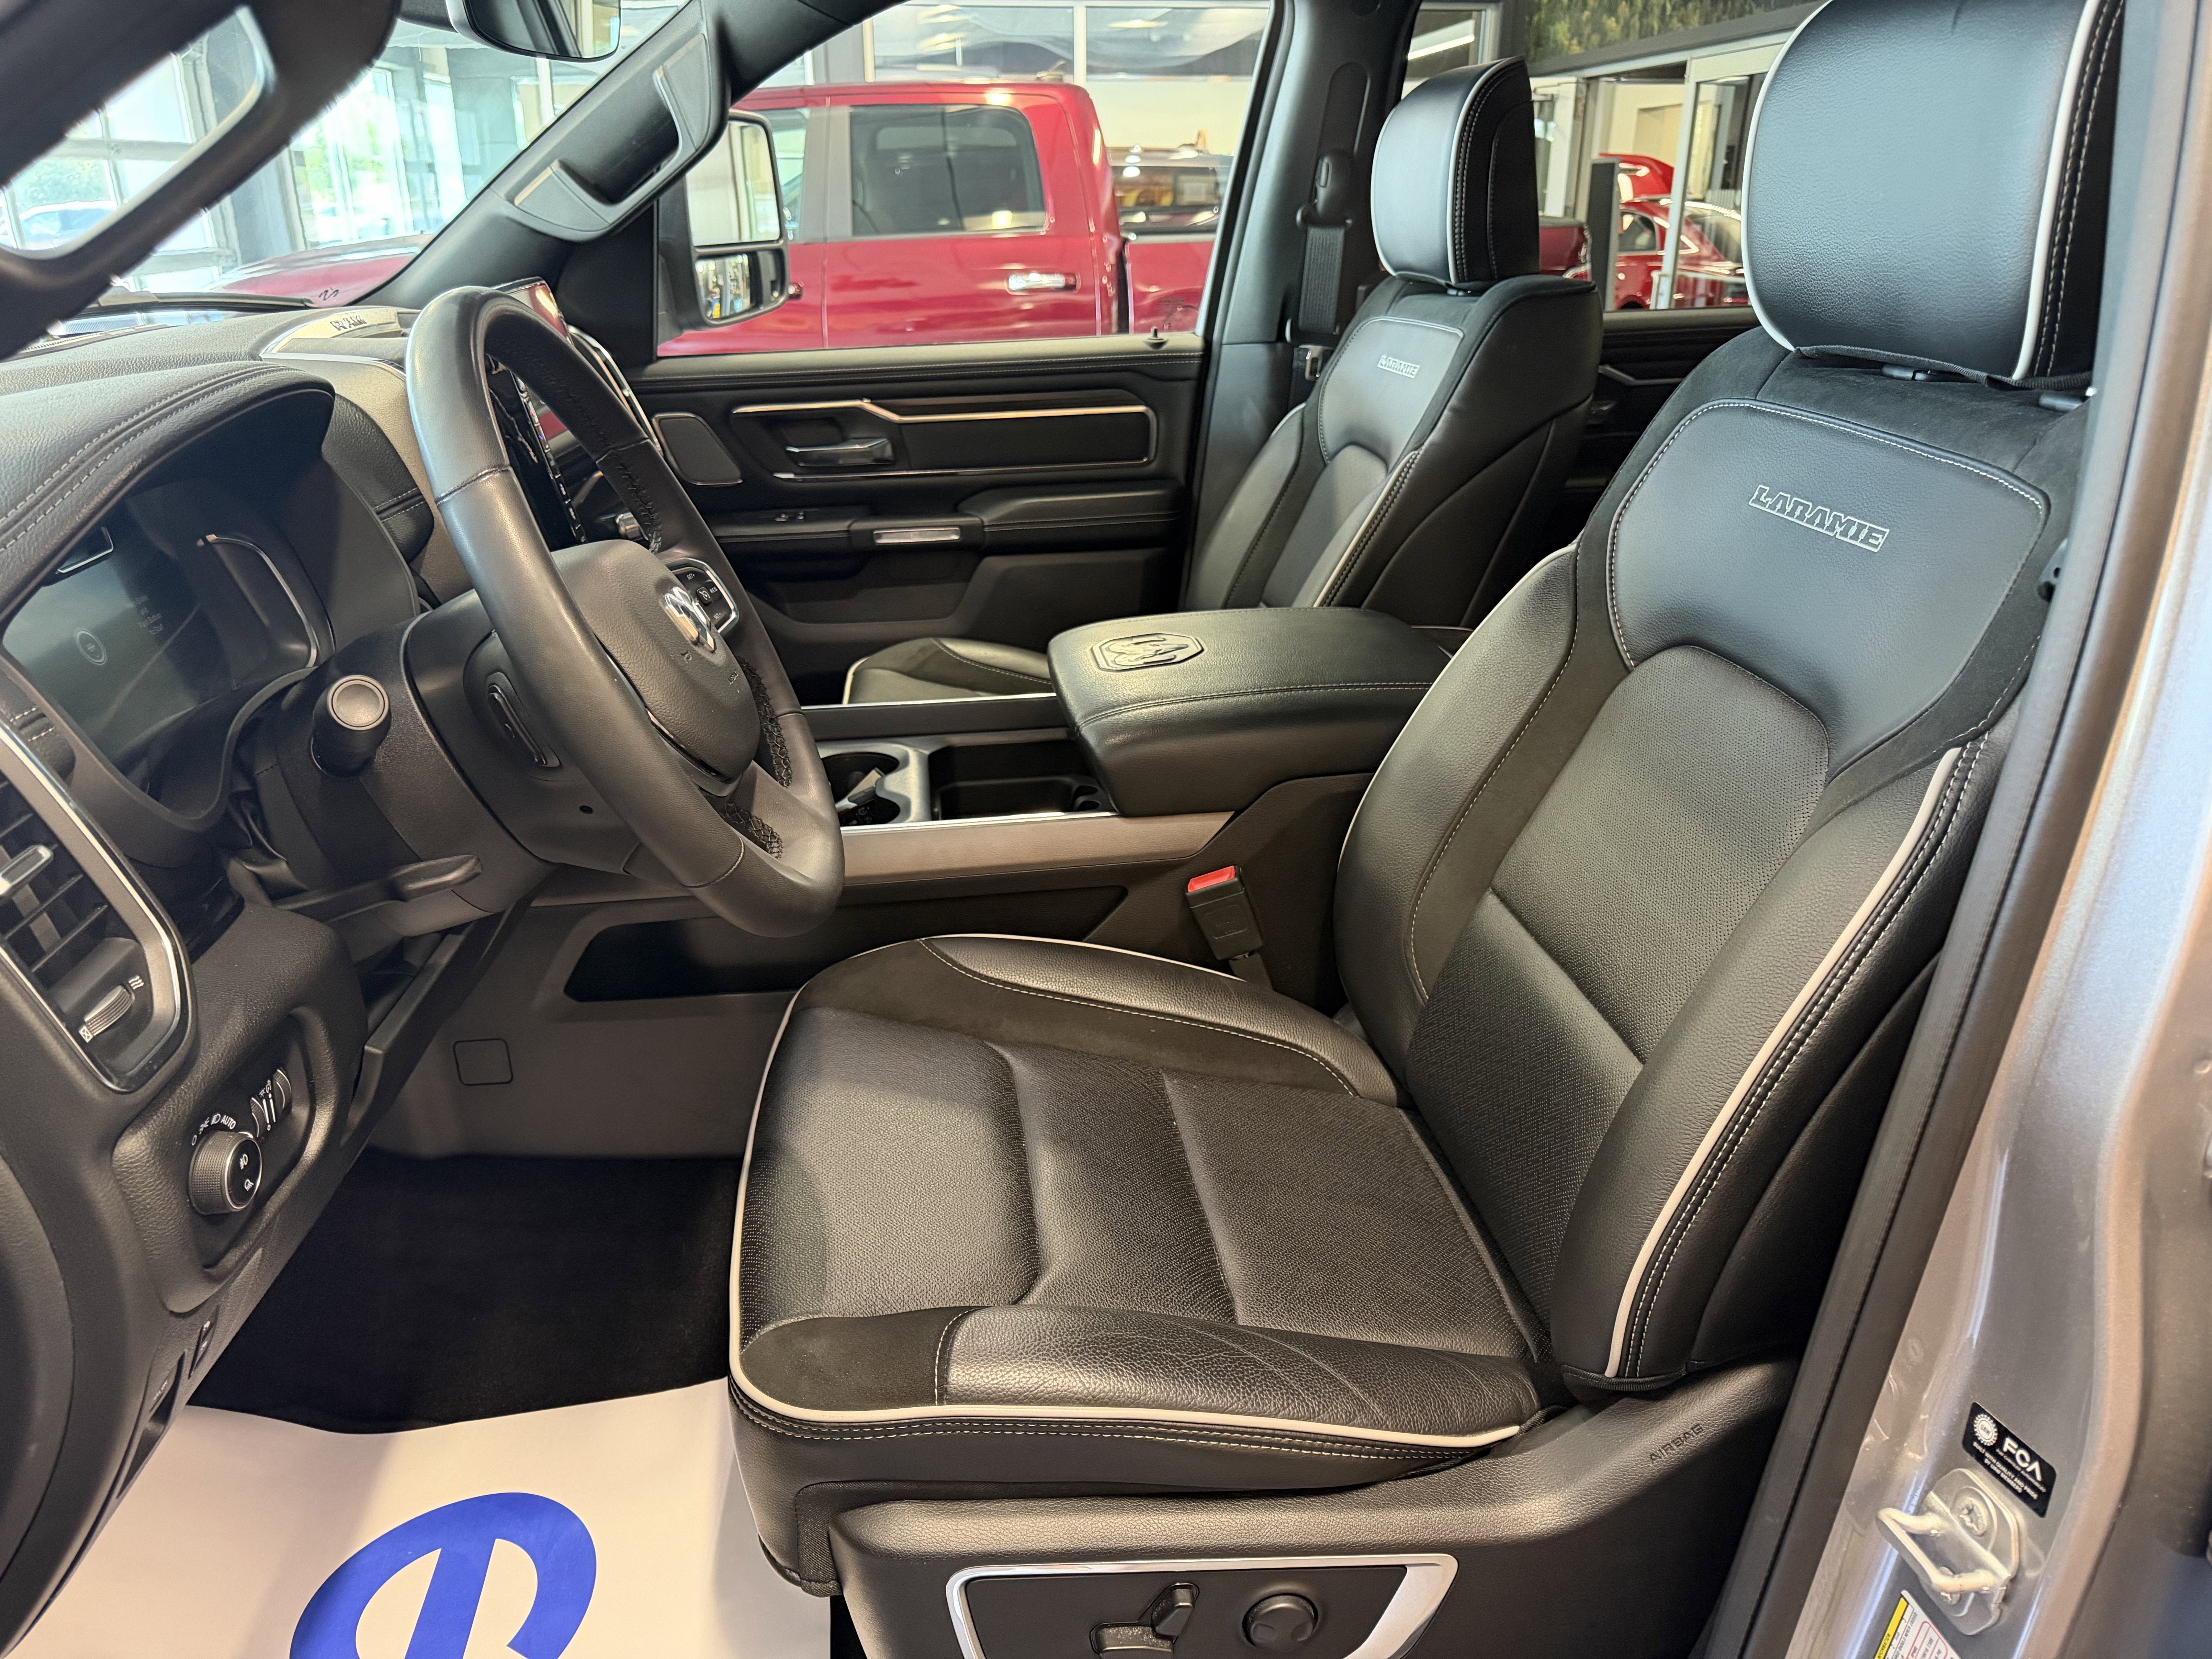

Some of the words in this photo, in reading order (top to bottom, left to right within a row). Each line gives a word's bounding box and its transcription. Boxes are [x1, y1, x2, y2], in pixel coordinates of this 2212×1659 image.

[1748, 484, 1890, 553] LARAMIE
[220, 1115, 236, 1130] AUTO
[1649, 1424, 1703, 1464] AIRBAG
[2002, 1436, 2042, 1481] FCA
